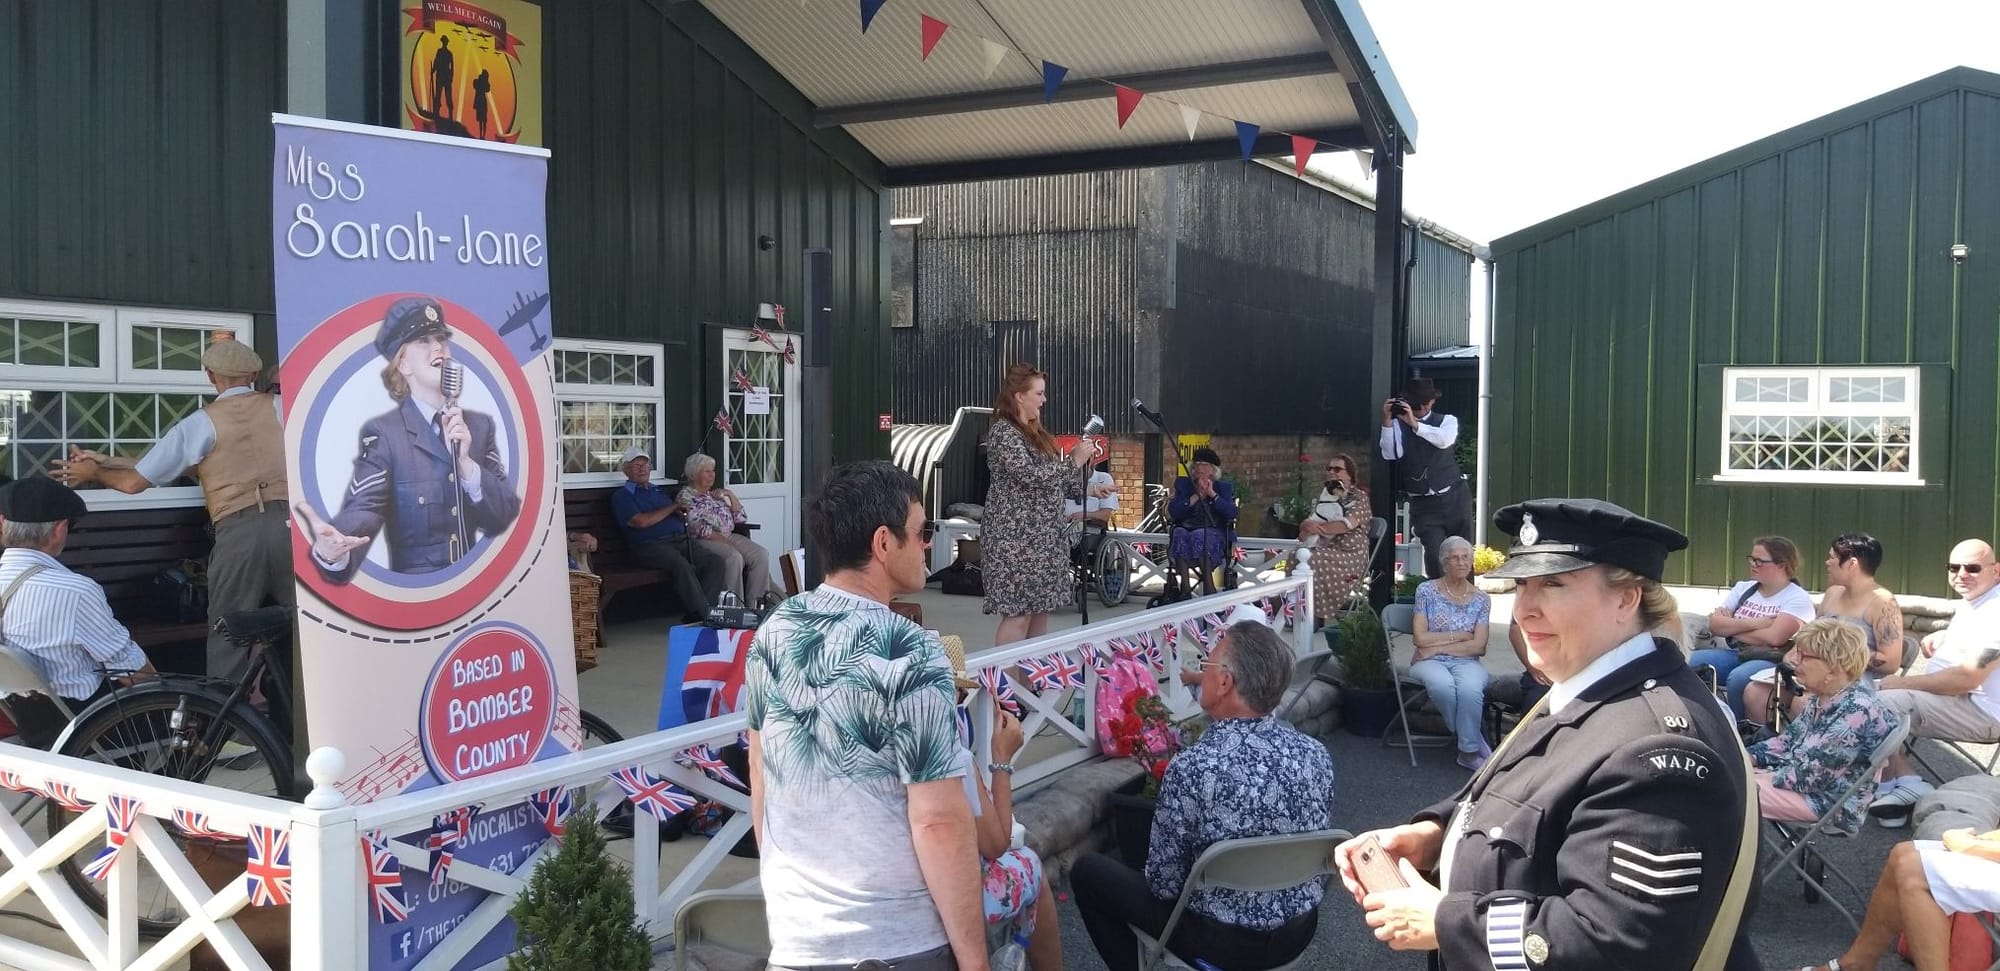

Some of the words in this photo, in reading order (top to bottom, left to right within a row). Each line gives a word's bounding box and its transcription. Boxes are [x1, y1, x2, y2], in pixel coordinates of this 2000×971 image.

[427, 2, 455, 14] WE'LL
[454, 7, 477, 19] MEET
[477, 14, 502, 30] AGAIN
[287, 203, 544, 267] Sarah-Jane
[453, 654, 503, 687] BASED
[511, 648, 526, 672] IN
[449, 685, 533, 733] BOMBER
[1664, 715, 1688, 728] 80
[456, 730, 531, 775] COUNTY
[1649, 754, 1709, 779] WAPC
